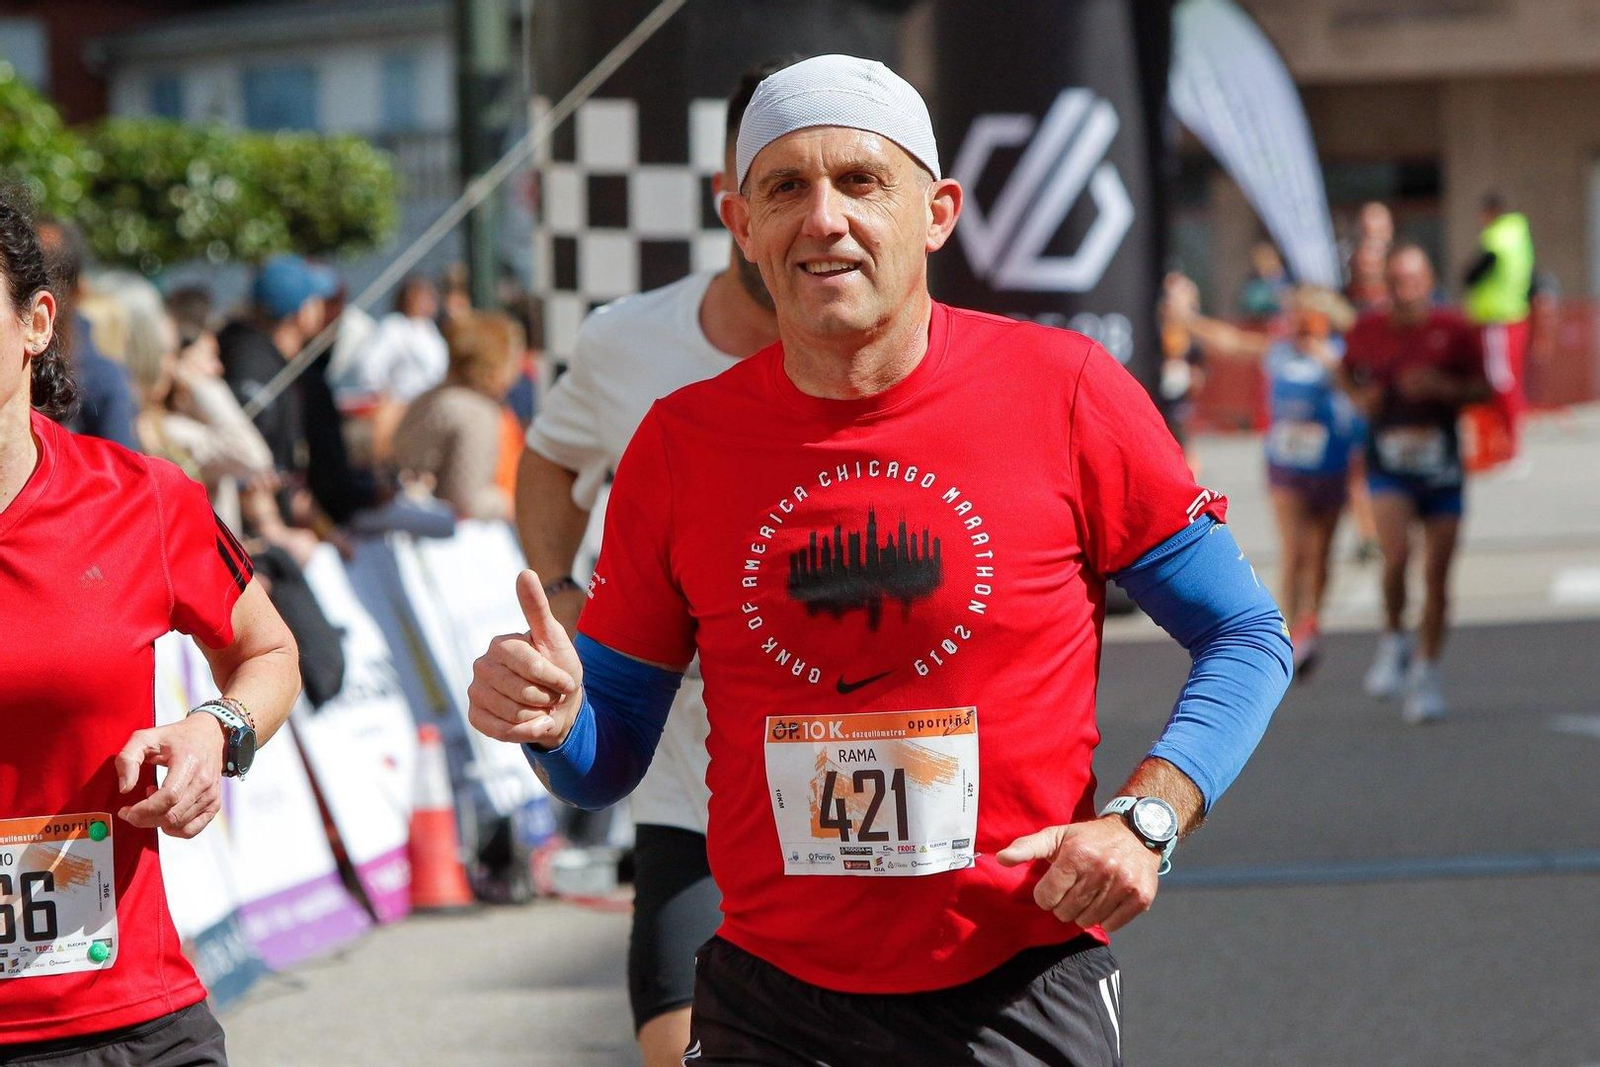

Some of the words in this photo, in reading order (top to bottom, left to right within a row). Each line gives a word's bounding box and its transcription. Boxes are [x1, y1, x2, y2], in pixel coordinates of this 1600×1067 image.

[818, 460, 936, 488] CHICAGO
[742, 486, 808, 588] AMERICA
[942, 487, 995, 614] MARATHON
[742, 602, 763, 630] OF
[914, 624, 972, 677] 2019
[838, 749, 877, 763] RAMA
[820, 768, 909, 842] 421
[45, 818, 106, 836] oporri
